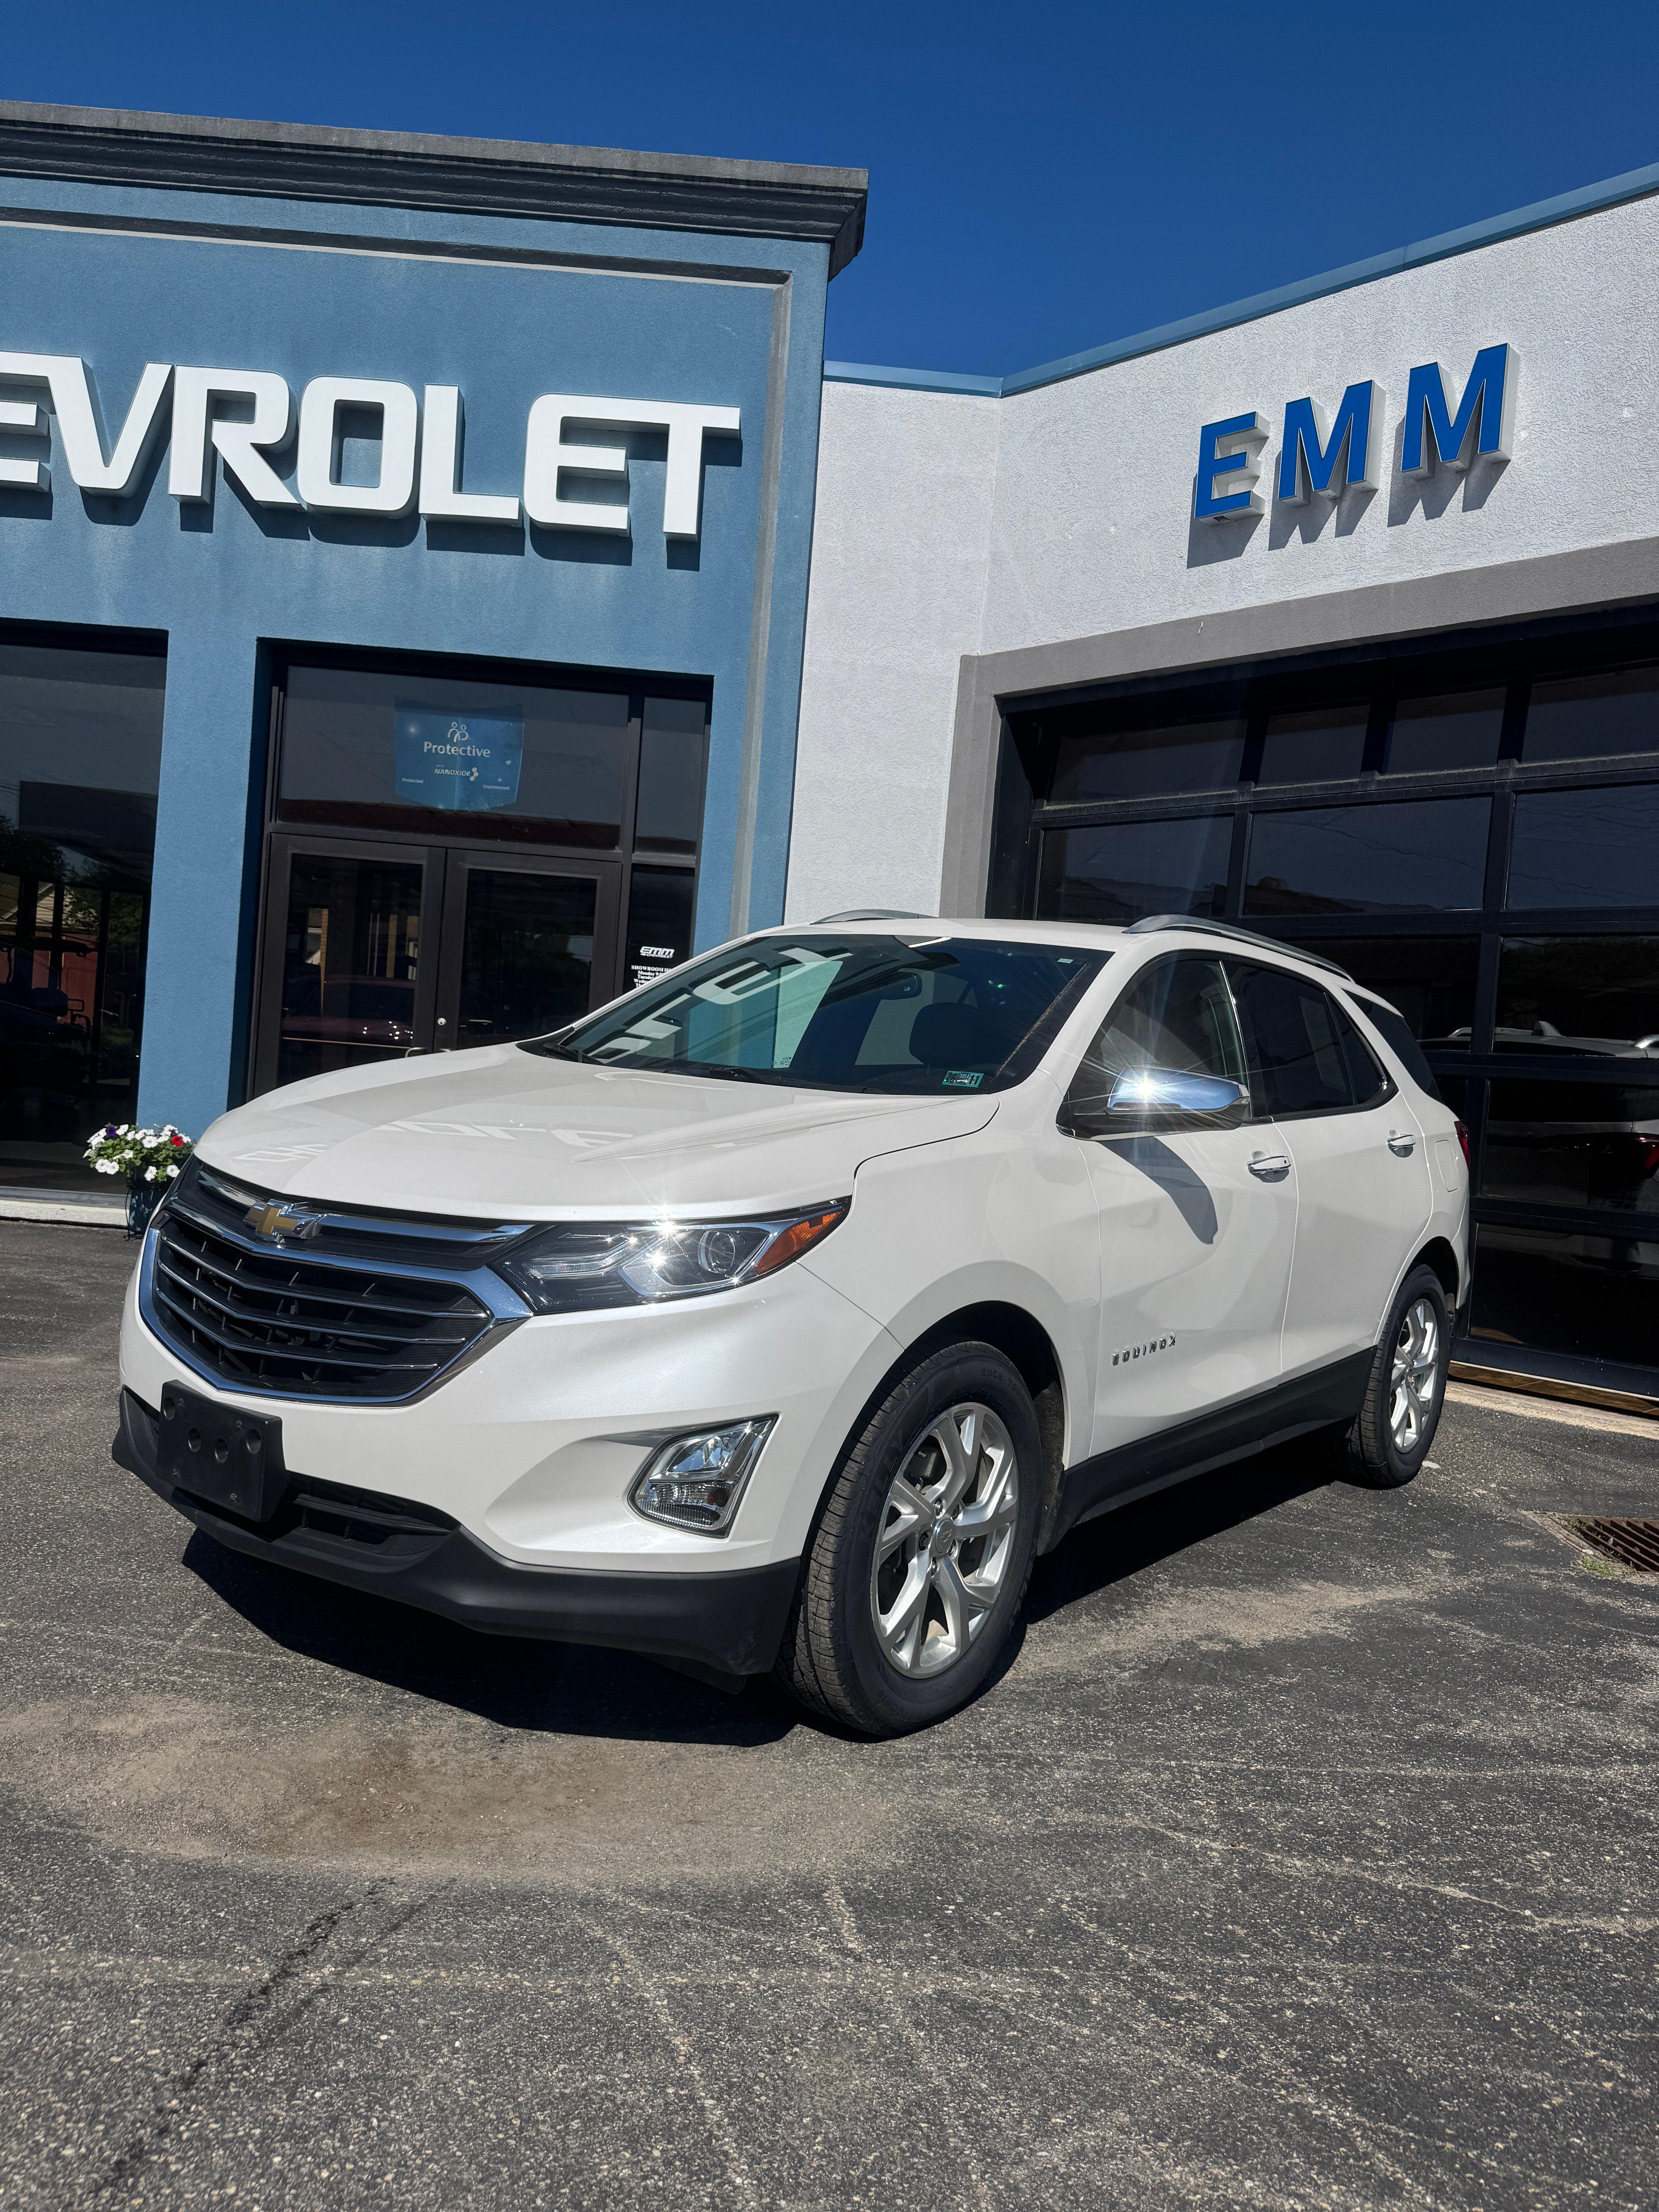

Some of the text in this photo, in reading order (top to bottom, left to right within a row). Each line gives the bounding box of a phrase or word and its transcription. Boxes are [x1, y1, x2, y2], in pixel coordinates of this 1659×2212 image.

[1194, 342, 1517, 524] EMM
[424, 741, 491, 757] Protective
[434, 768, 471, 777] NANOXIDE
[1113, 1334, 1176, 1366] EQUINOX
